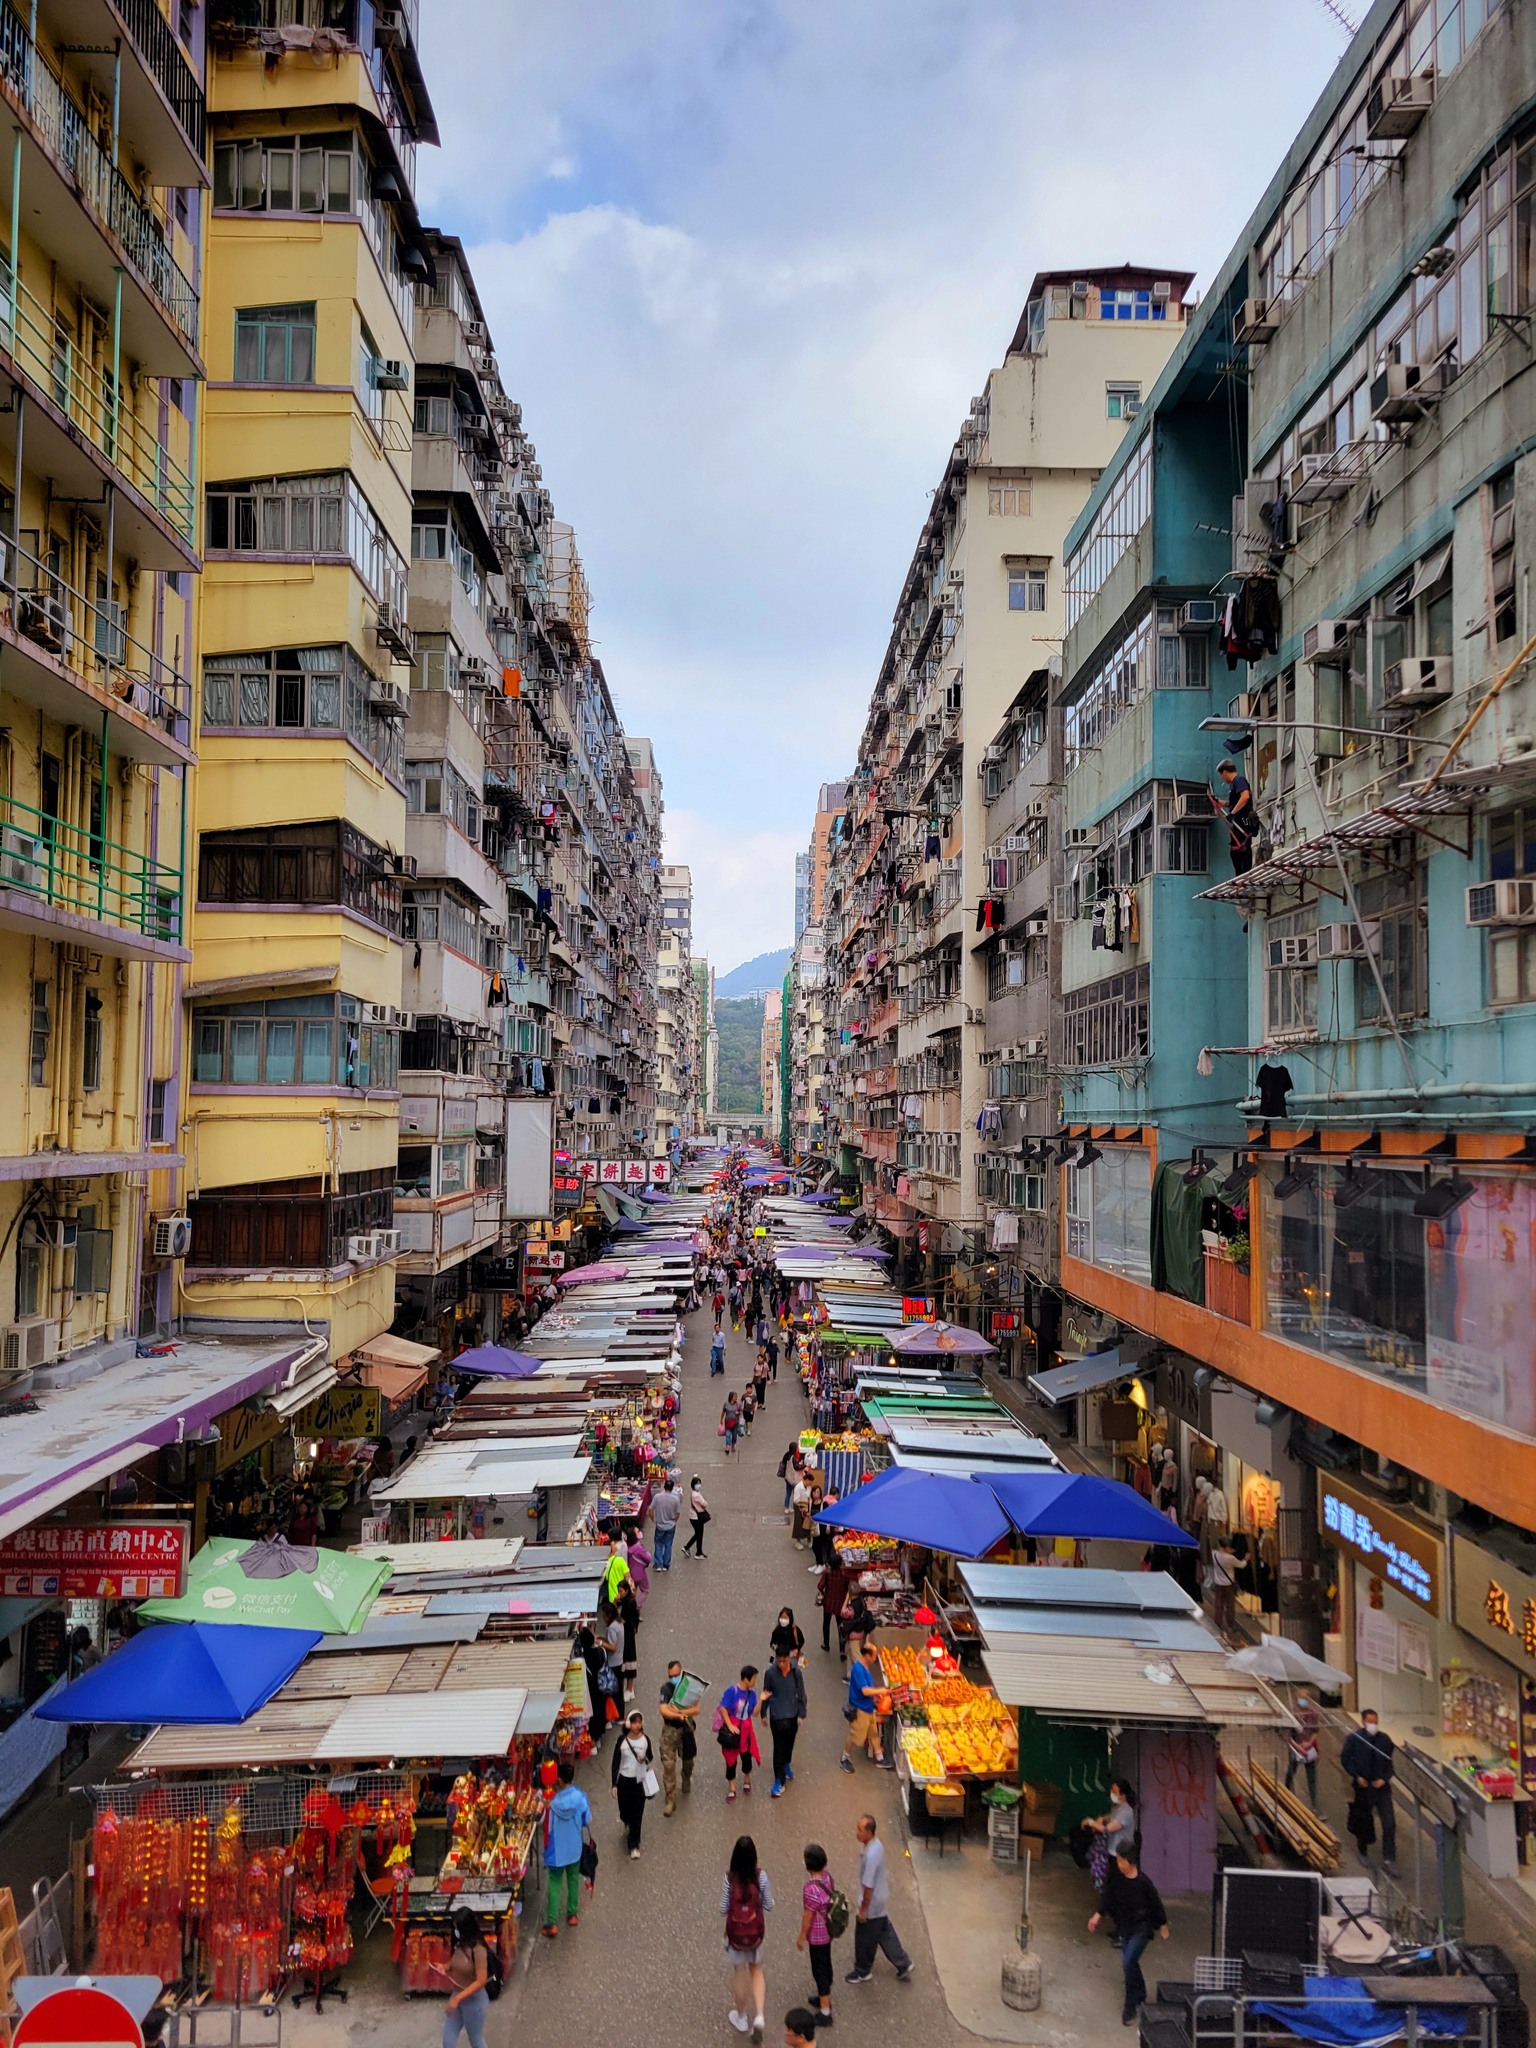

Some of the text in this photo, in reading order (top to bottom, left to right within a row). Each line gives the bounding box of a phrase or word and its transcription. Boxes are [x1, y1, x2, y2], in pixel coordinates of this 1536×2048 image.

[28, 1552, 60, 1560] PHONE
[62, 1552, 97, 1560] DIRECT
[99, 1552, 139, 1561] SELLING
[140, 1552, 178, 1561] CENTRE
[241, 1593, 298, 1605] 微信支付
[238, 1604, 292, 1614] WeChat Pay
